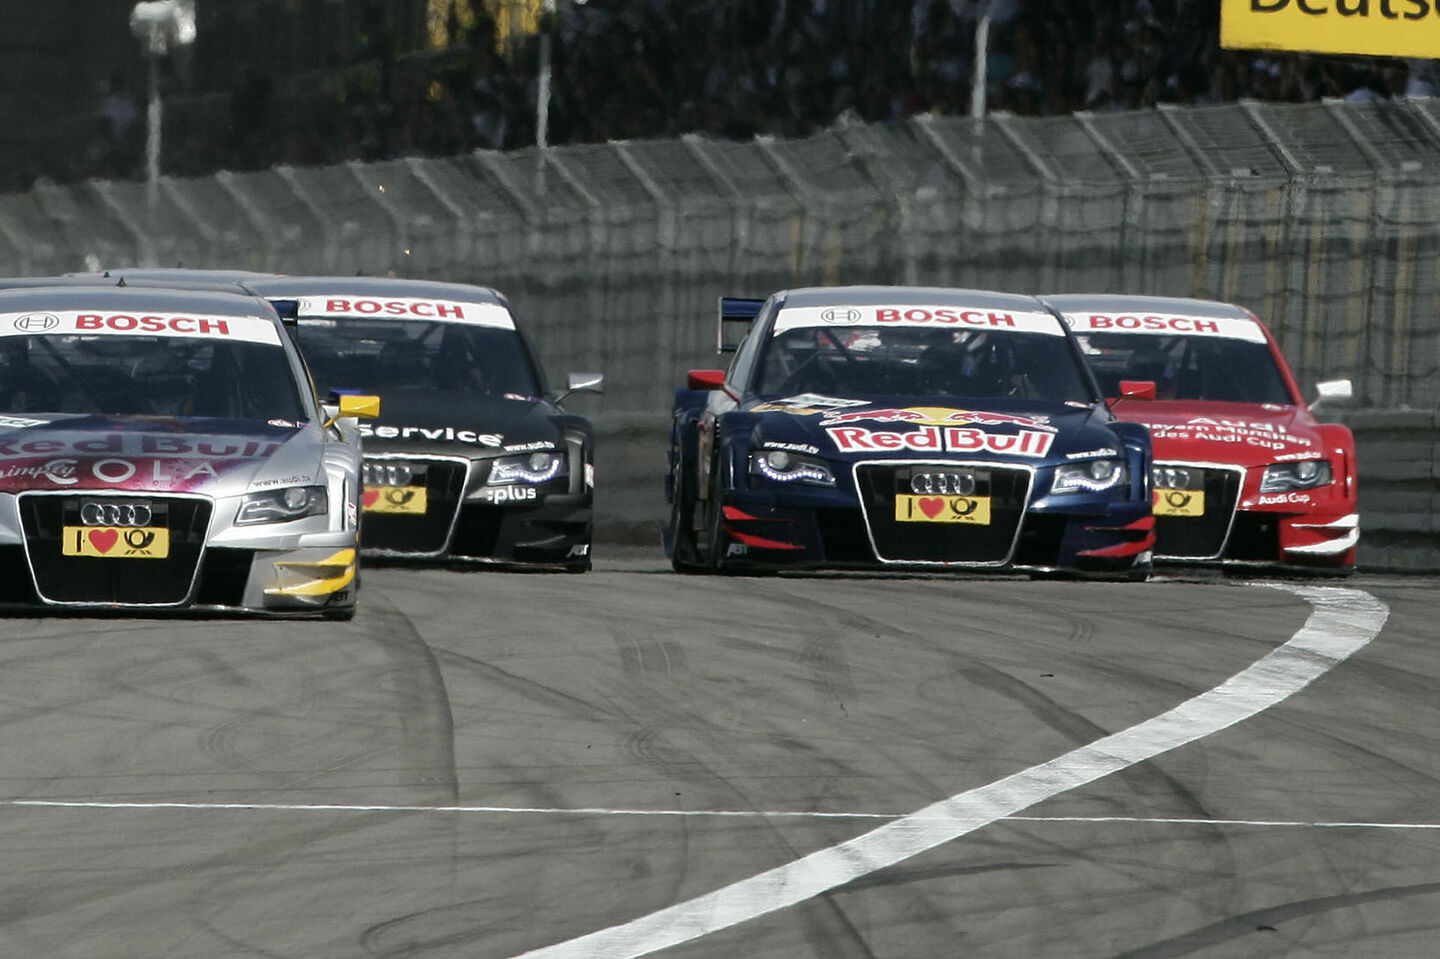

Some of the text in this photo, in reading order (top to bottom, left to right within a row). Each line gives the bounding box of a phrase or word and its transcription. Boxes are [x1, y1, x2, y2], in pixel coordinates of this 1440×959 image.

[326, 299, 465, 319] BOSCH
[875, 309, 1015, 327] BOSCH
[75, 314, 230, 335] BOSCH
[1089, 315, 1220, 333] BOSCH
[358, 424, 502, 447] Service
[1188, 417, 1286, 434] Audi
[142, 435, 282, 457] Bull
[828, 426, 1054, 456] Red Bull
[1153, 430, 1286, 450] des Audi Cup
[1216, 425, 1312, 447] München
[763, 441, 820, 455] www.audi.tv
[1258, 492, 1311, 505] Audi Cup
